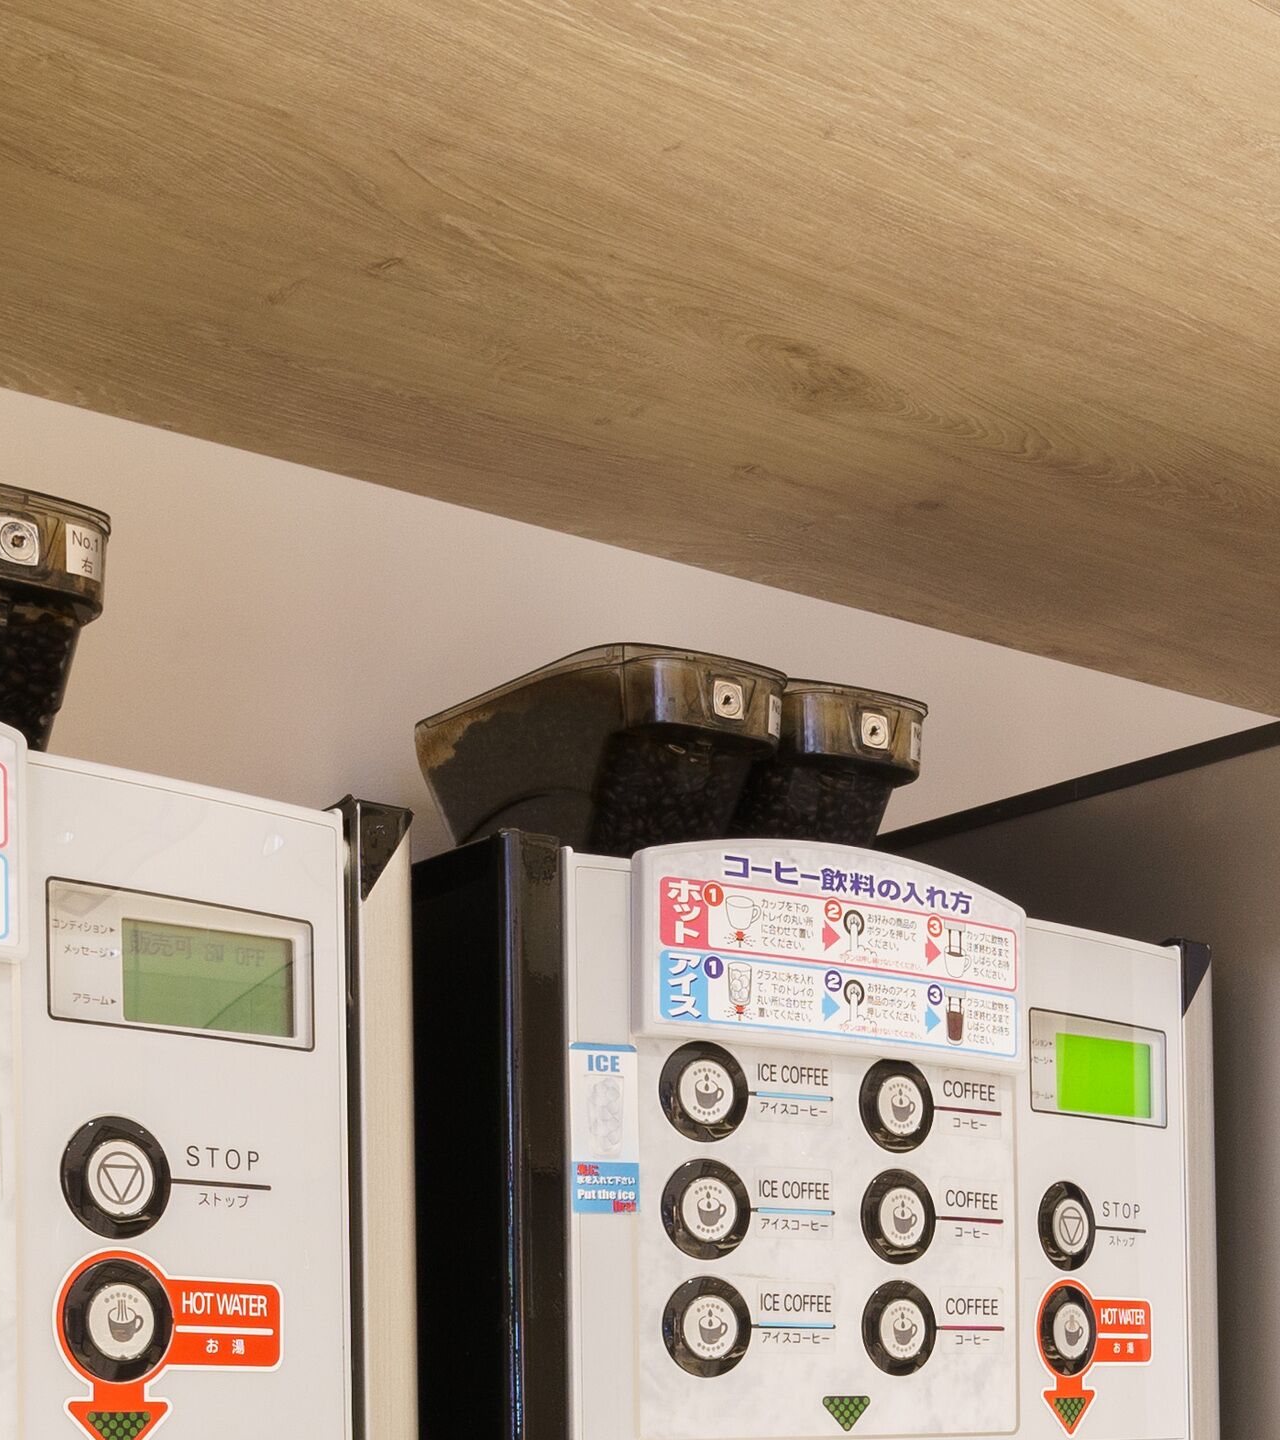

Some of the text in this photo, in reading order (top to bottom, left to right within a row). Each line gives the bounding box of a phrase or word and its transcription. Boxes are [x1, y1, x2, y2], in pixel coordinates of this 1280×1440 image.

[72, 530, 100, 553] No.1
[81, 557, 94, 574] 右
[723, 854, 972, 915] コーヒー飲料の入れ方
[667, 880, 702, 944] ホット
[667, 952, 701, 1018] アイス
[72, 992, 109, 1006] アラーム
[588, 1054, 620, 1073] ICE
[757, 1063, 829, 1087] ICE COFFEE
[943, 1079, 996, 1102] COFFEE
[759, 1102, 827, 1117] アイスコーヒー
[953, 1117, 987, 1130] コーヒー
[186, 1145, 260, 1171] STOP
[759, 1179, 830, 1201] ICE COFFEE
[199, 1192, 249, 1209] ストップ
[945, 1189, 998, 1211] COFFEE
[1103, 1201, 1140, 1219] STOP
[760, 1218, 828, 1232] アイスコーヒー
[955, 1227, 989, 1239] コーヒー
[1109, 1236, 1135, 1248] ストップ
[182, 1291, 268, 1317] HOT WATER
[760, 1293, 832, 1313] ICE COFFEE
[945, 1297, 999, 1316] COFFEE
[1101, 1308, 1145, 1326] HOT WATER
[206, 1338, 245, 1355] お湯
[761, 1332, 830, 1345] アイスコーヒー
[955, 1334, 990, 1346] コーヒー
